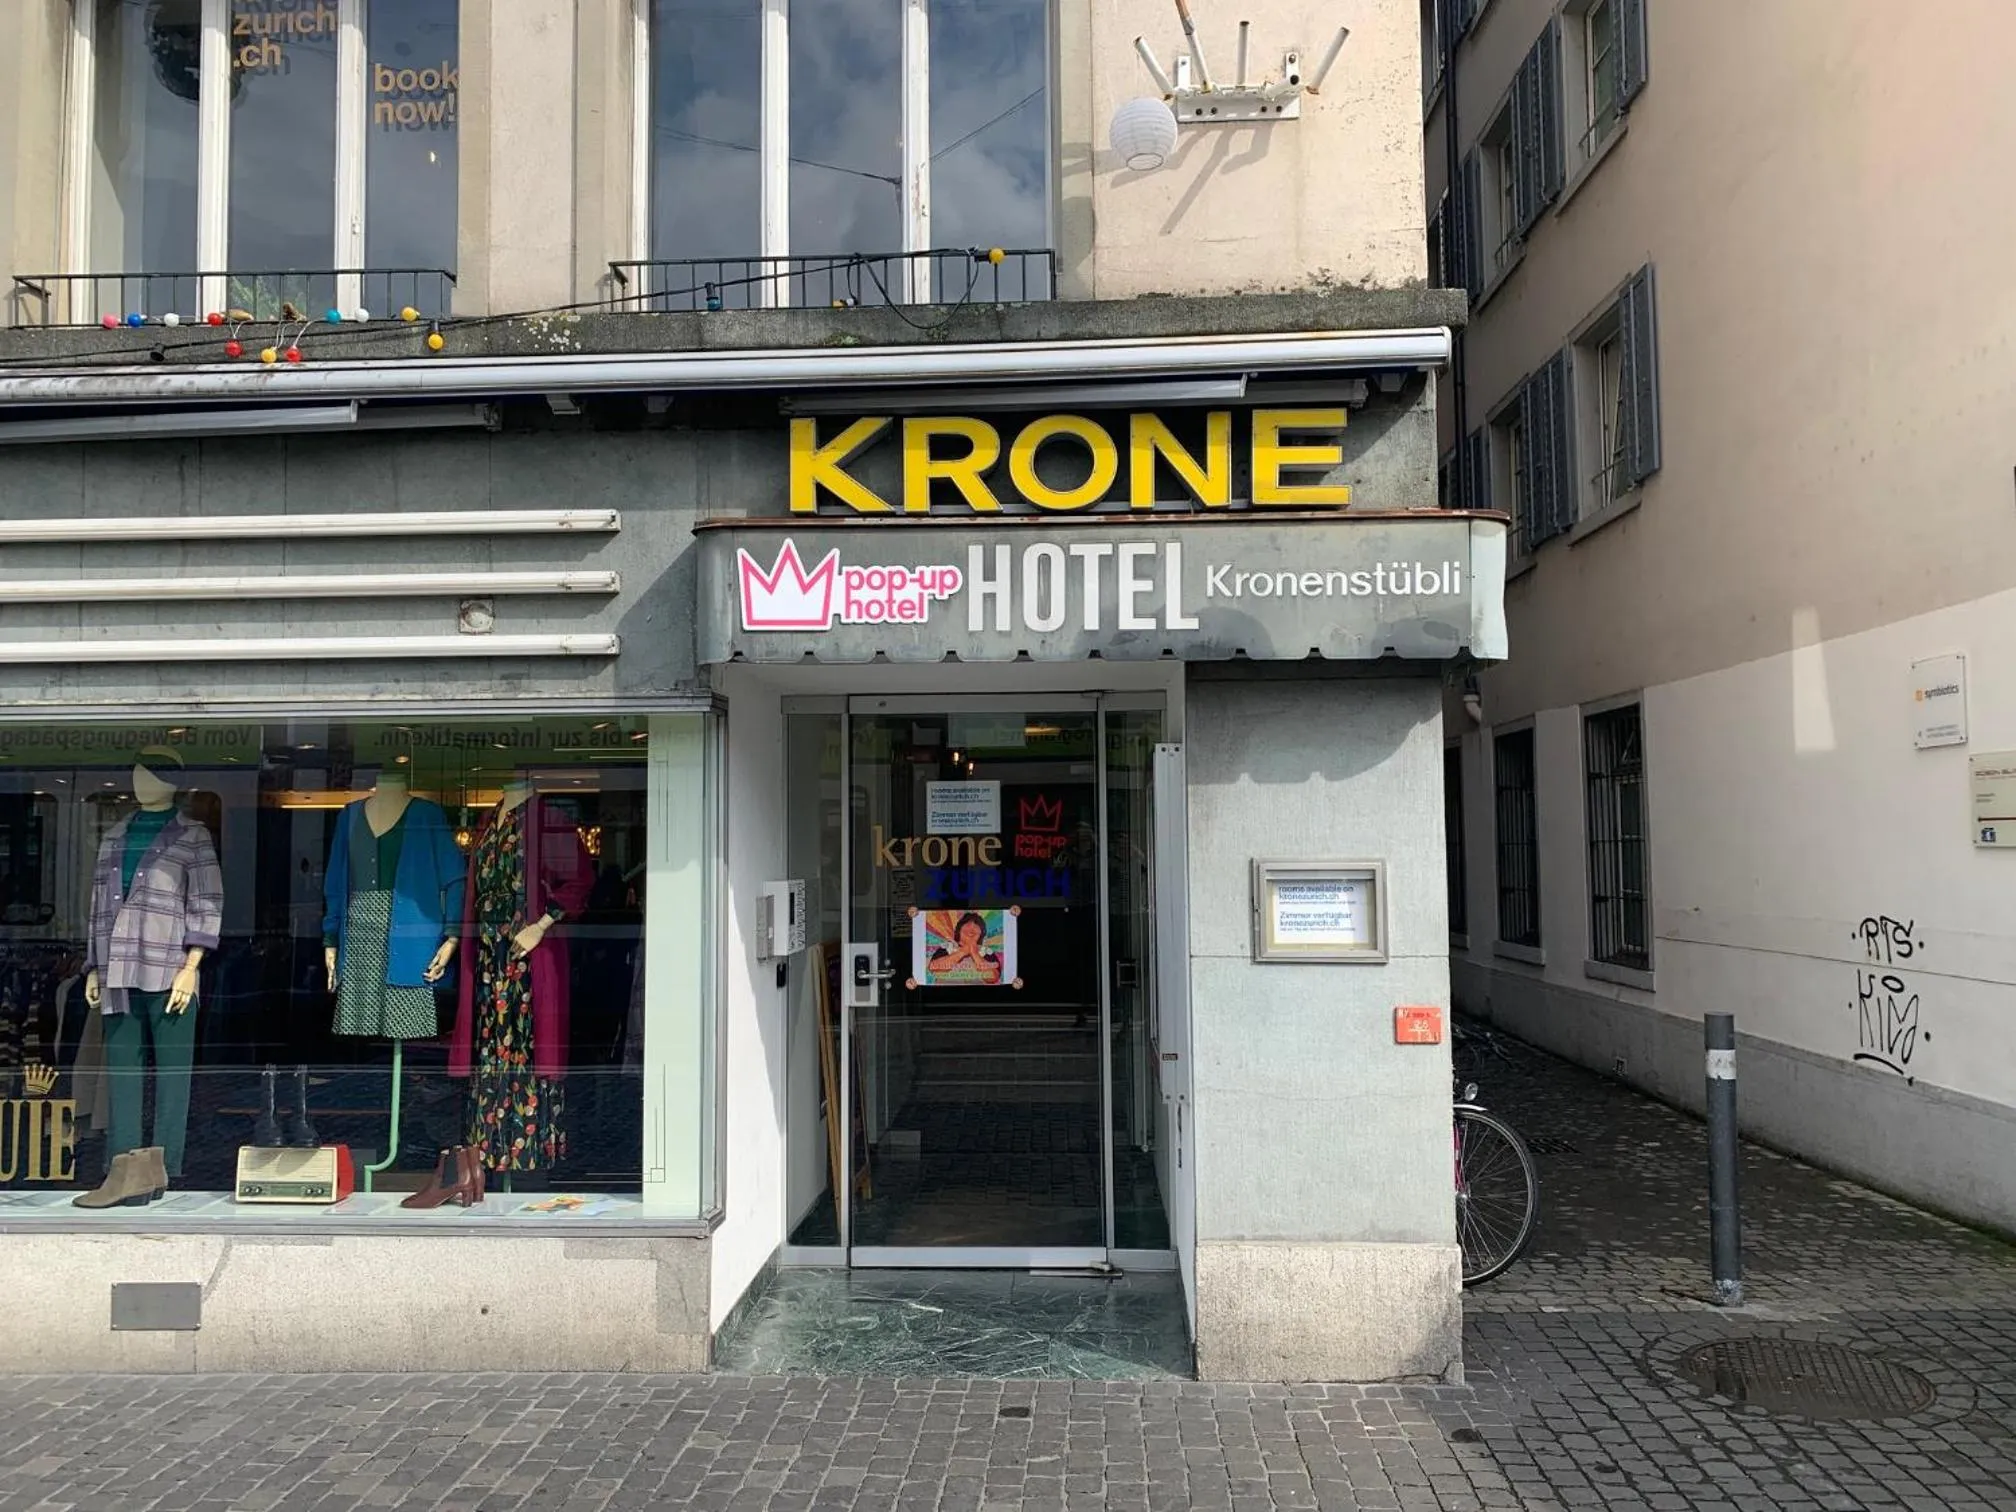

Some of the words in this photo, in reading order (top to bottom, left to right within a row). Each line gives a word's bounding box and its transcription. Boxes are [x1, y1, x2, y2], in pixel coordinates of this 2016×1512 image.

[233, 3, 336, 36] zurich
[233, 37, 281, 67] .ch
[374, 60, 459, 93] book
[374, 93, 455, 124] now!
[789, 407, 1352, 515] KRONE
[845, 569, 959, 597] pop-up
[967, 540, 1200, 632] HOTEL
[1205, 561, 1461, 598] Kronenstübli
[845, 592, 925, 619] hotel
[872, 824, 1002, 867] krone
